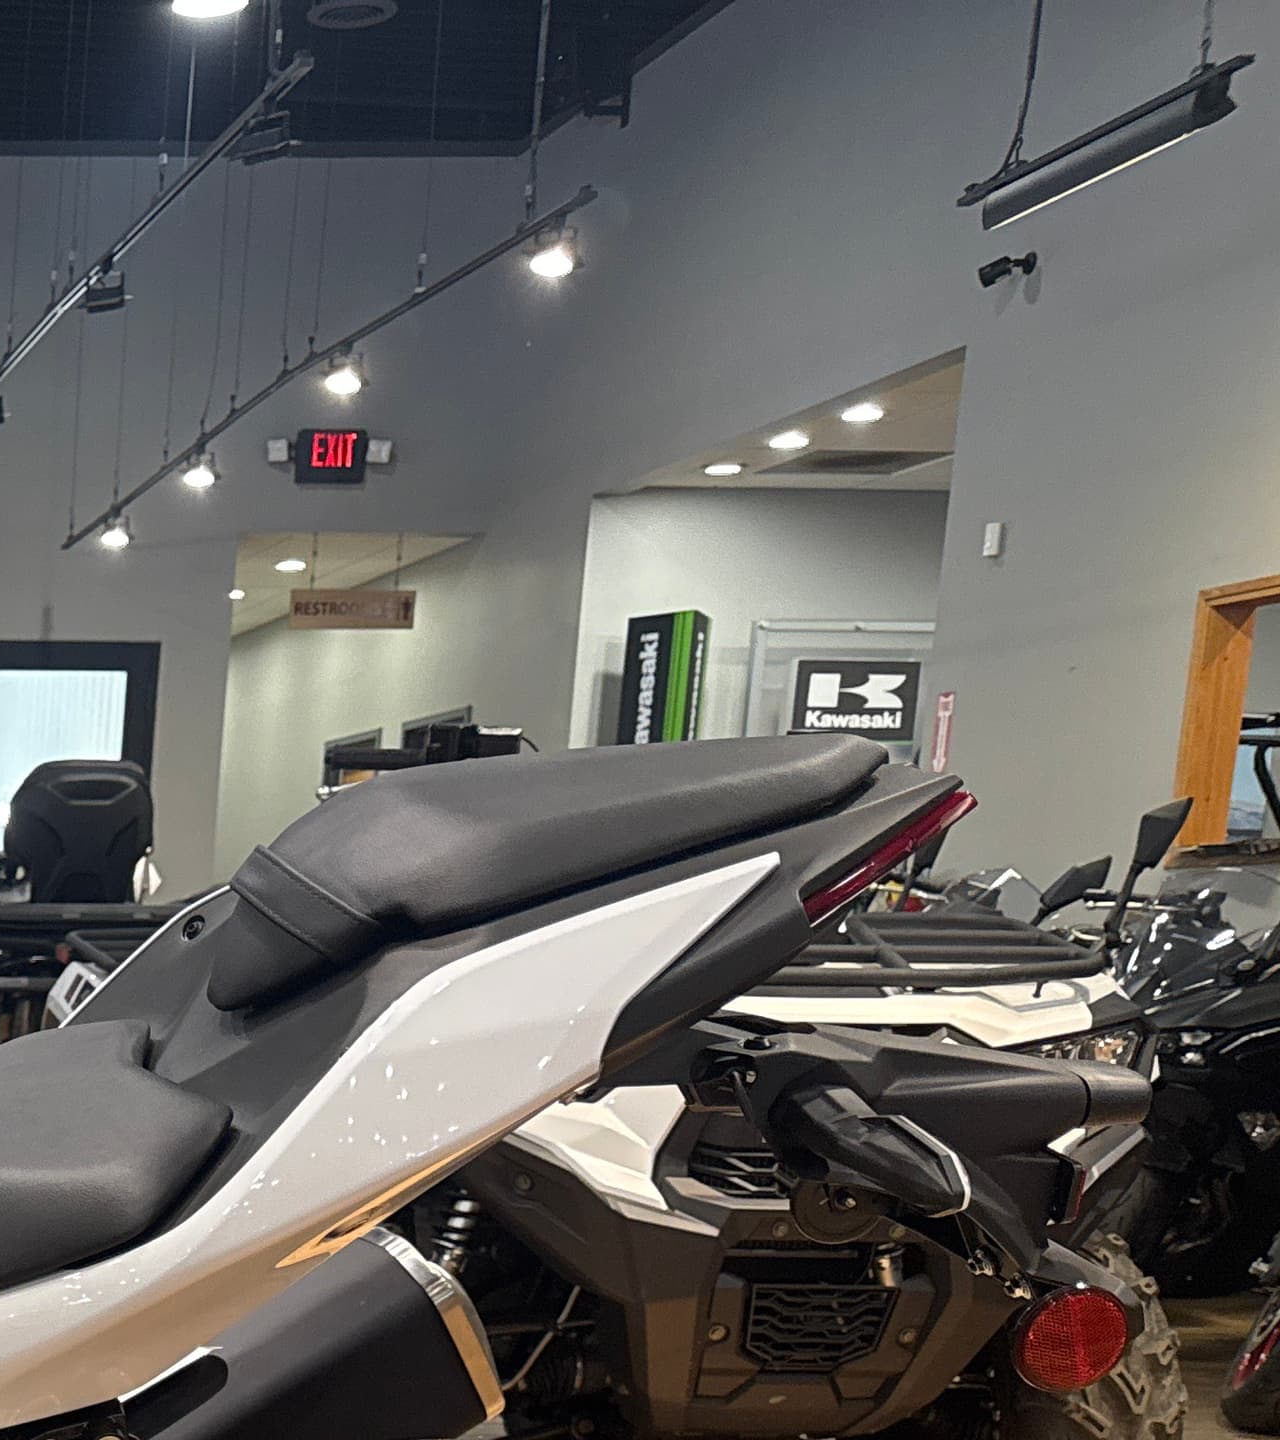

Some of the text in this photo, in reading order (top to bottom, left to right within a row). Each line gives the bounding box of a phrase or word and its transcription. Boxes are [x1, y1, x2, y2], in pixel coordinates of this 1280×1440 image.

[311, 432, 357, 468] EXIT
[634, 632, 659, 744] awasaki
[805, 710, 902, 729] Kawasaki
